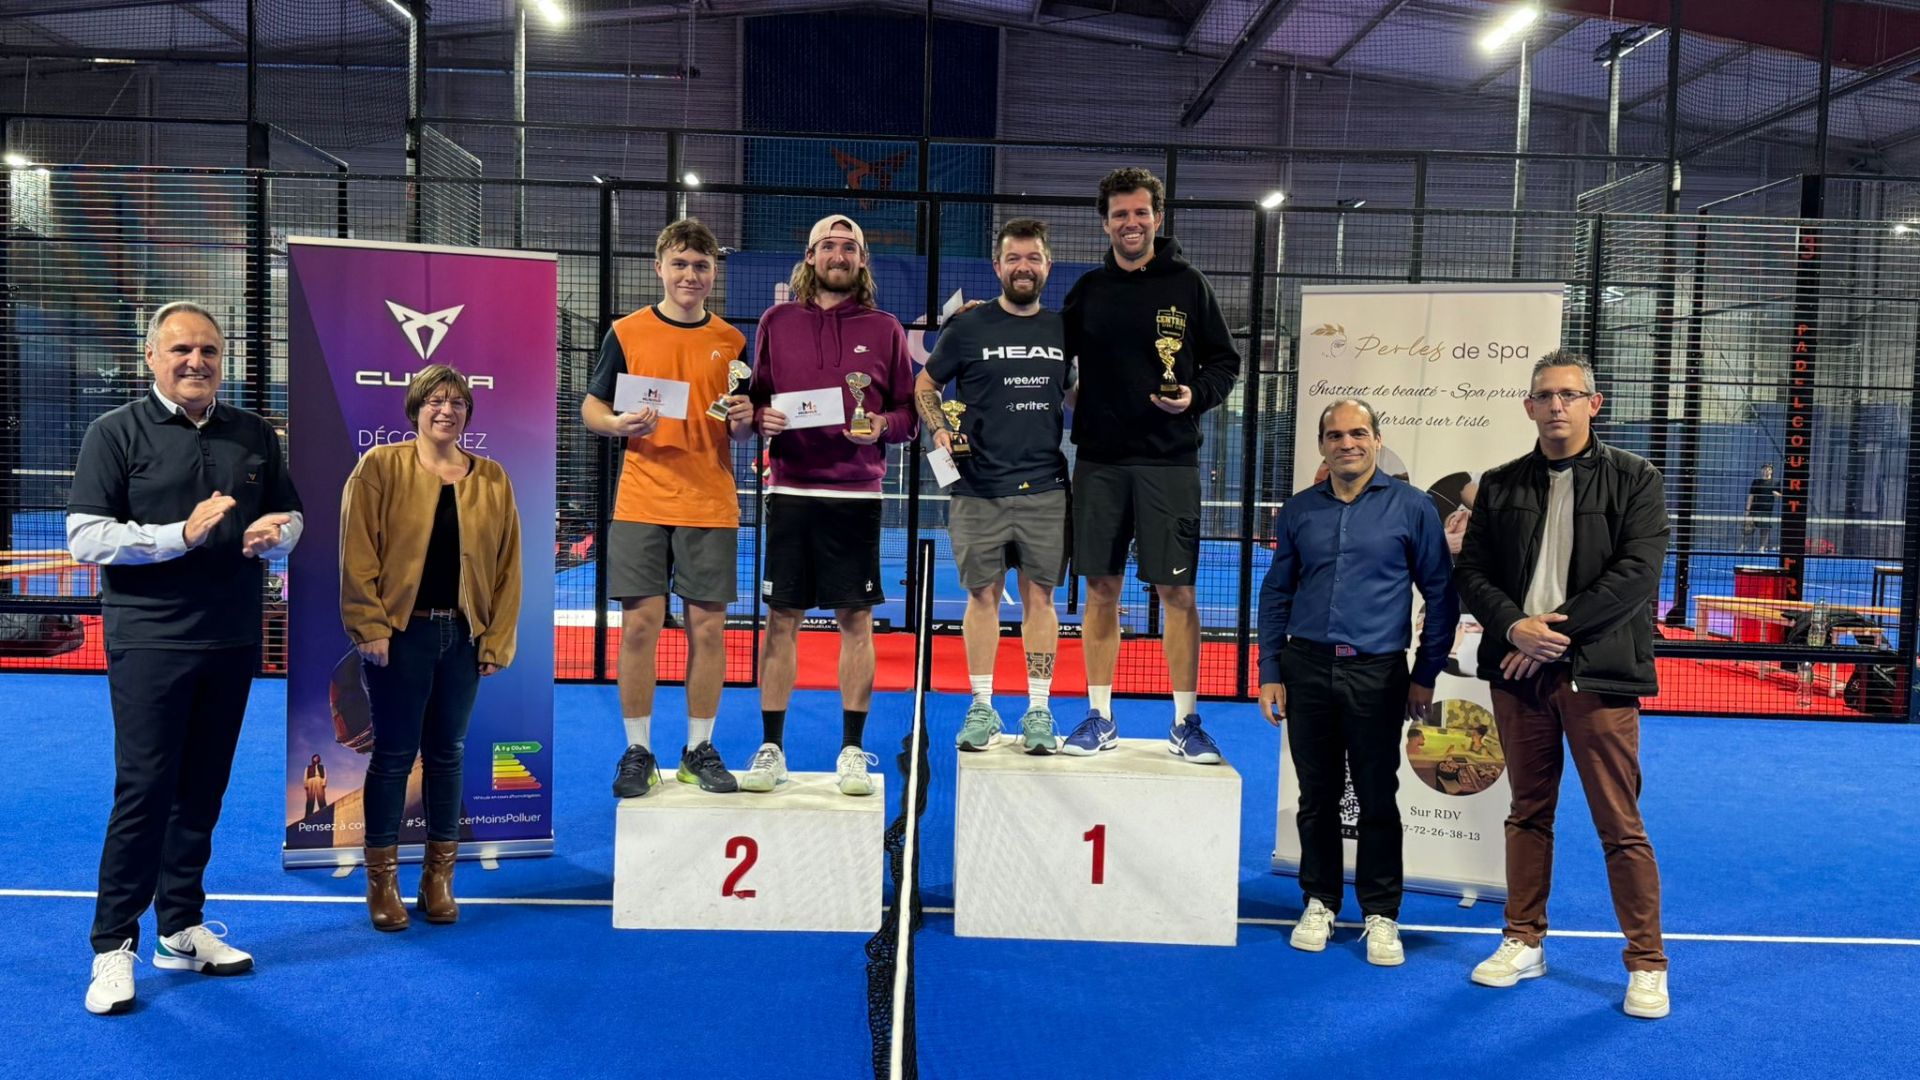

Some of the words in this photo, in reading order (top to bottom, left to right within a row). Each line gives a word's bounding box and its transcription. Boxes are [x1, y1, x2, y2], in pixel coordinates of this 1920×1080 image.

[982, 346, 1064, 361] HEAD
[1354, 334, 1446, 362] Perles
[1452, 342, 1480, 359] de
[1488, 342, 1529, 364] Spa
[356, 371, 494, 389] CUA
[1309, 380, 1371, 397] Institut
[1372, 385, 1390, 397] de
[1391, 385, 1438, 397] beauté
[1450, 382, 1486, 400] Spa
[1016, 401, 1050, 411] eritec
[1425, 417, 1453, 427] sur
[1410, 806, 1431, 816] Sur
[1434, 808, 1462, 820] RDV
[298, 823, 336, 833] Pensez
[1403, 825, 1481, 841] 7-72-26-38-13
[1083, 824, 1105, 884] 1
[722, 836, 758, 899] 2
